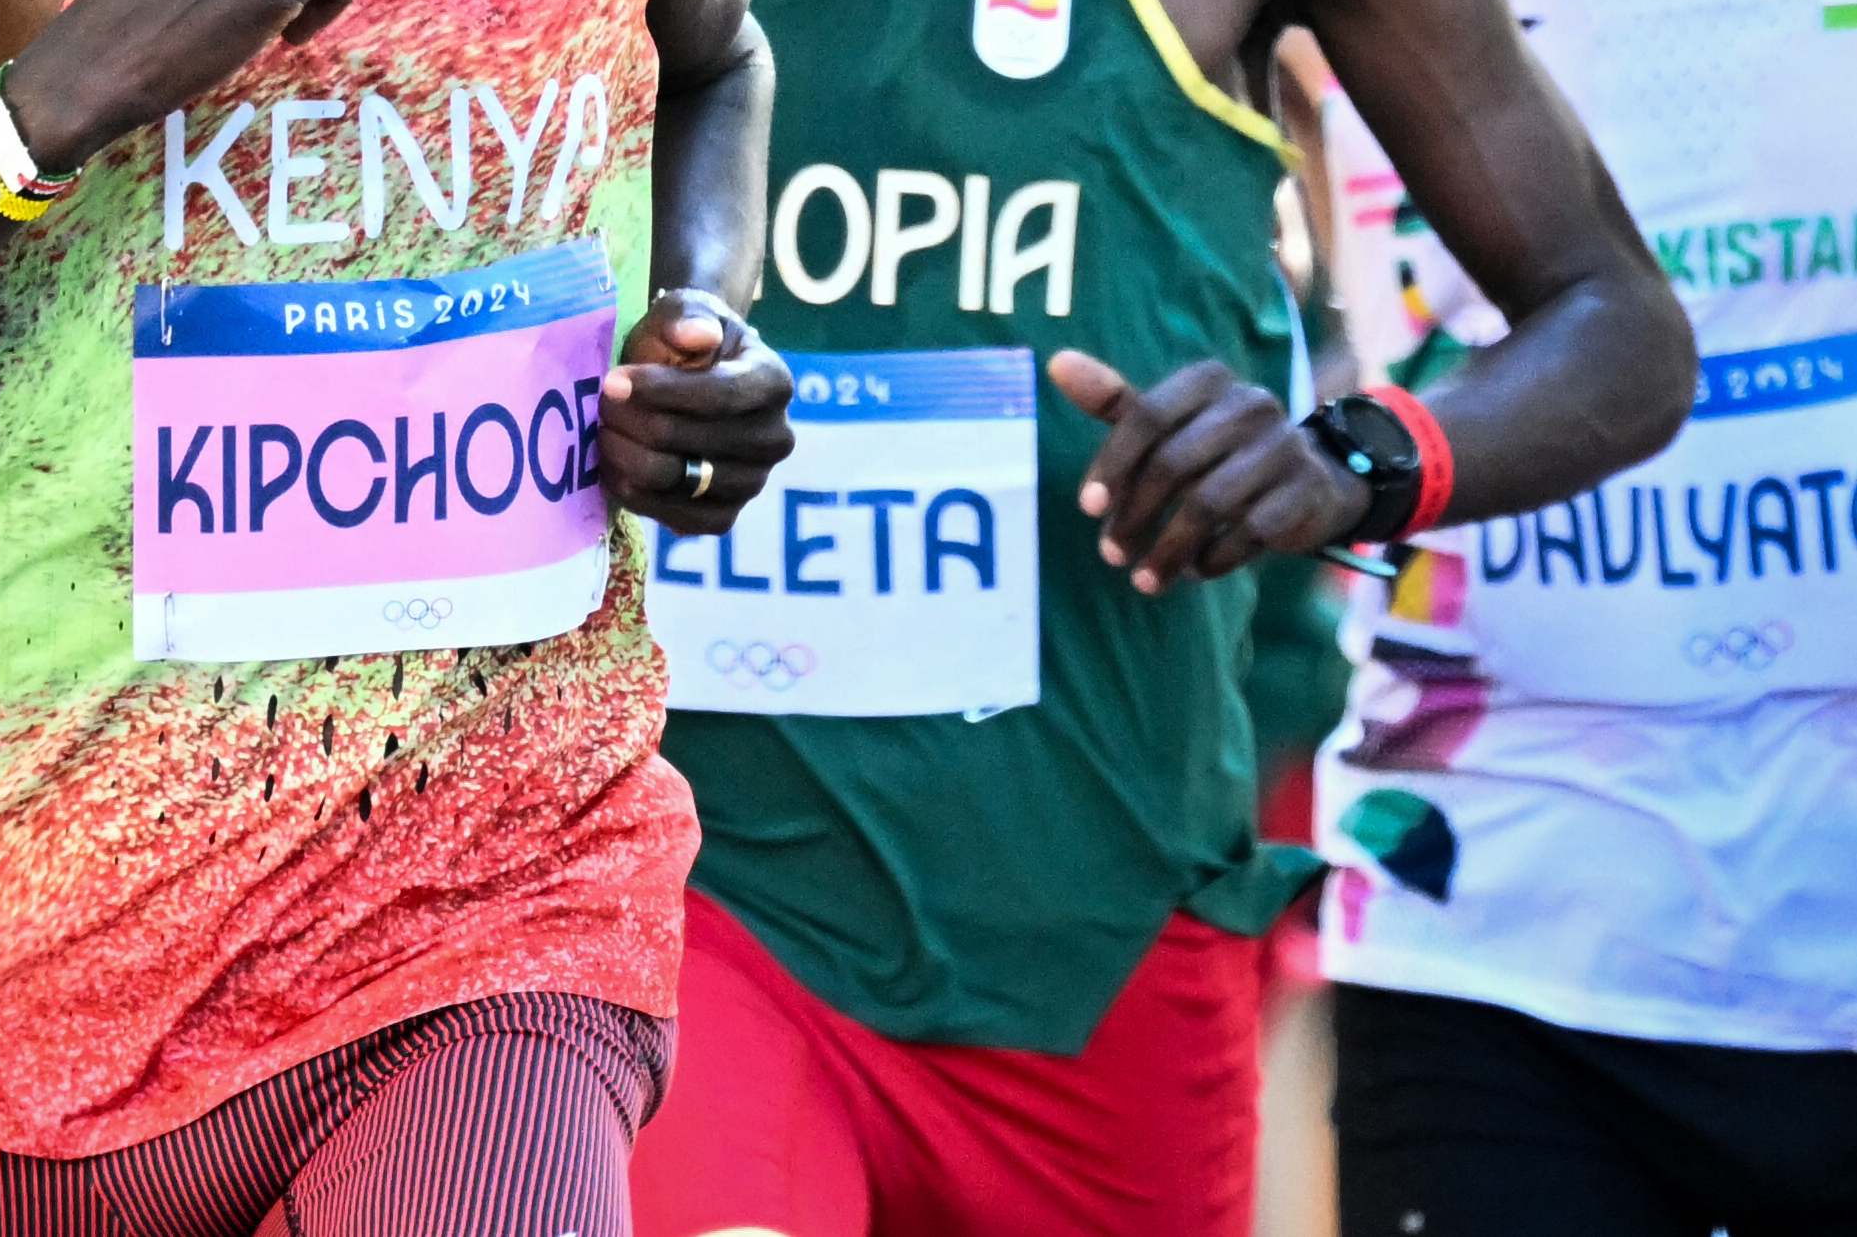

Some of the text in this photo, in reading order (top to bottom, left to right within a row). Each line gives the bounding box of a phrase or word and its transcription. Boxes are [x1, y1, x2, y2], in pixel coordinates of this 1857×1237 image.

[163, 73, 608, 250] KENYA
[433, 279, 531, 326] 2024
[753, 163, 1081, 317] OPIA
[1655, 214, 1857, 286] KISTA
[156, 375, 601, 534] KIPCHOGE
